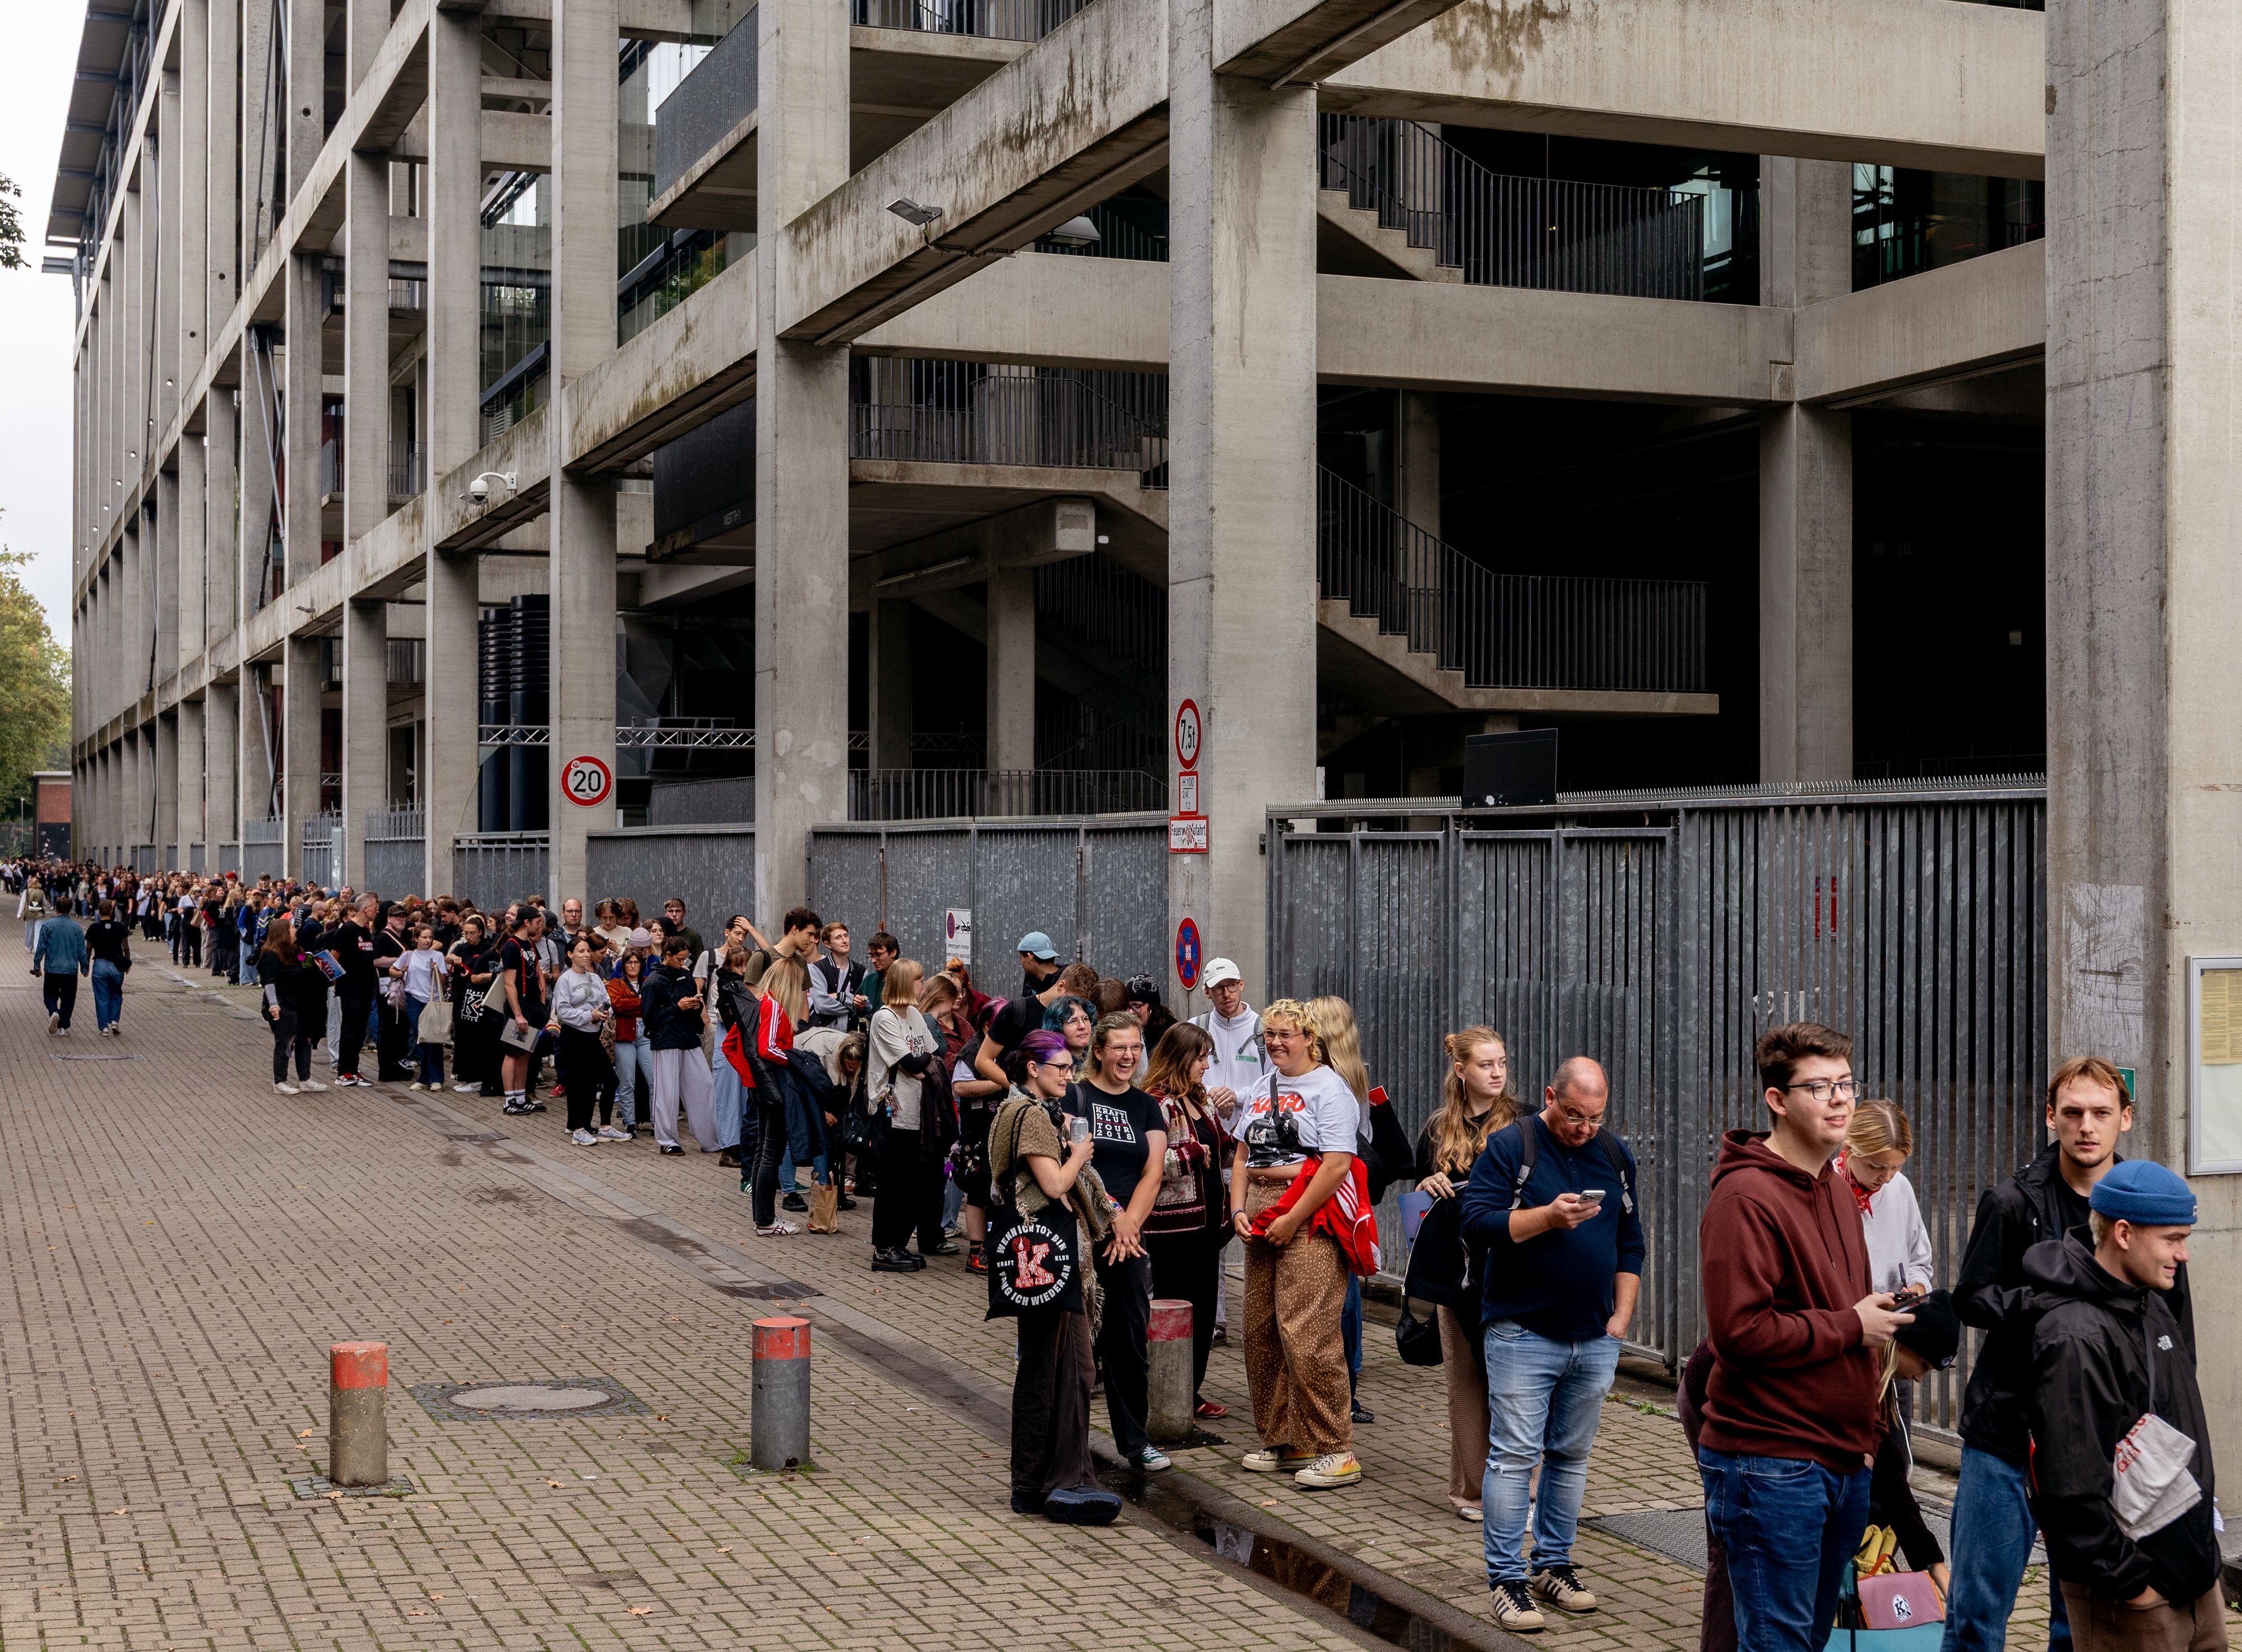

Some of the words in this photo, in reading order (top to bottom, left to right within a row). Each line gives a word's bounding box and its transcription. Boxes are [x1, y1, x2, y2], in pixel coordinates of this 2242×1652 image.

[573, 770, 601, 792] 20
[1182, 777, 1186, 787] H
[1095, 1106, 1124, 1119] KRAFT
[1096, 1113, 1127, 1124] KLUB
[1097, 1122, 1131, 1133] TOUR
[1096, 1129, 1132, 1140] 2018
[997, 1225, 1018, 1254] WENN
[1017, 1224, 1034, 1235] ICH
[1036, 1224, 1052, 1237] TOT
[1051, 1235, 1067, 1251] BIN
[999, 1270, 1013, 1296] FANG
[1010, 1292, 1029, 1306] ICH
[1030, 1278, 1066, 1306] WIEDER
[1060, 1265, 1071, 1280] AN
[1894, 1600, 1906, 1616] K
